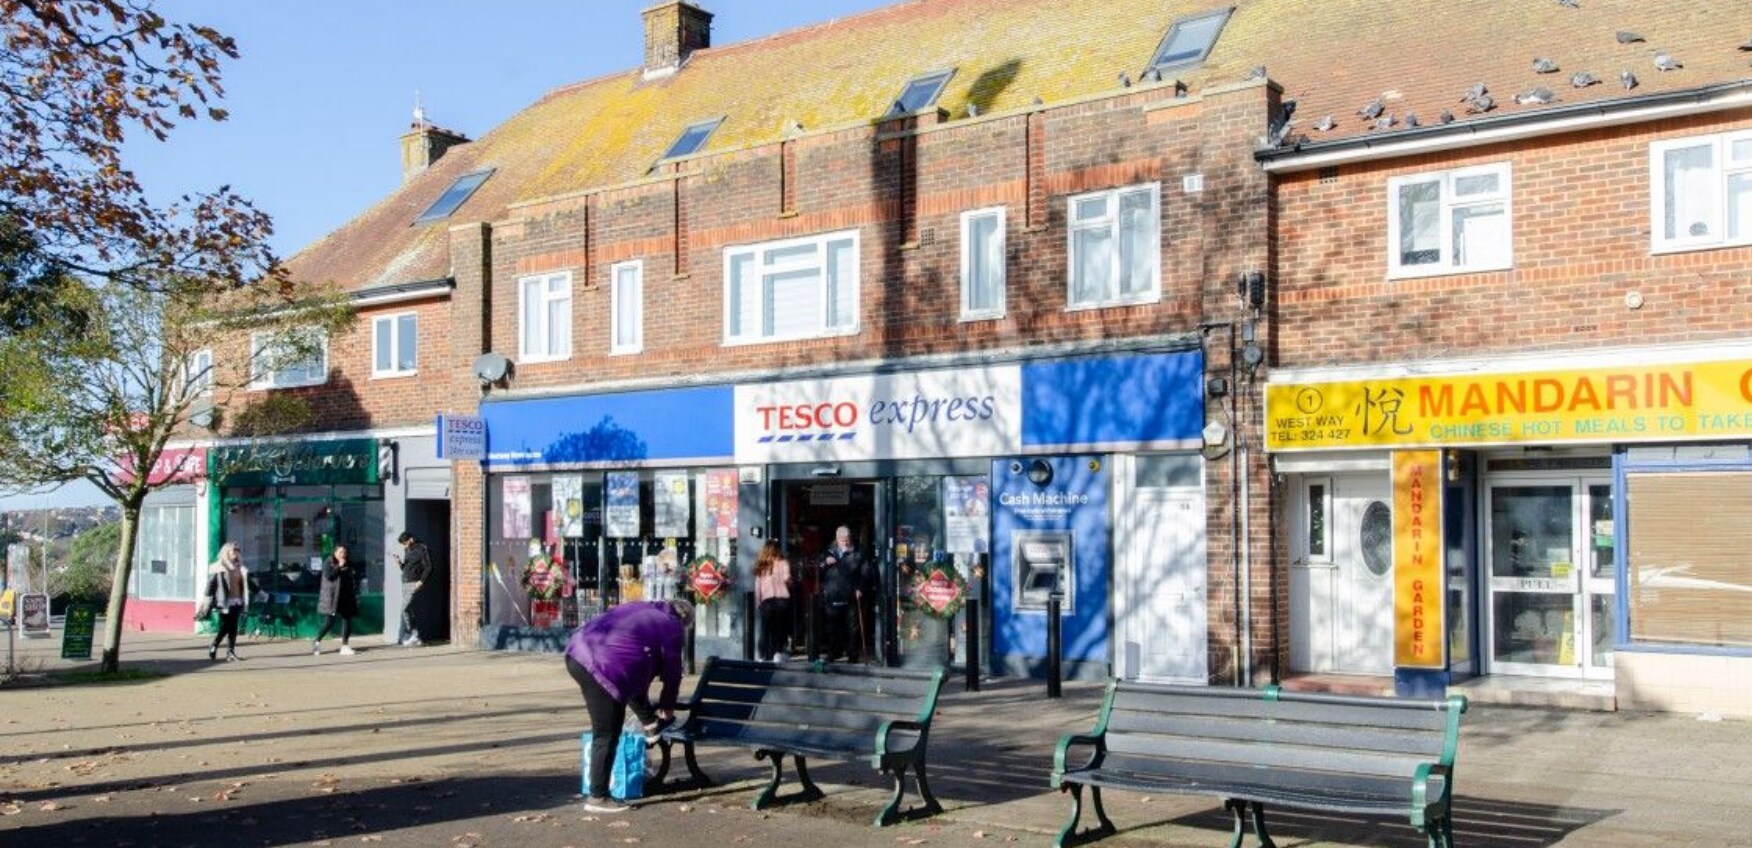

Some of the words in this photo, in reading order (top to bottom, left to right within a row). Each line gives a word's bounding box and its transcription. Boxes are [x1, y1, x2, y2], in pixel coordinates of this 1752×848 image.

[1418, 371, 1693, 418] MANDARIN
[756, 402, 858, 430] TESCO
[870, 395, 995, 433] express
[1276, 417, 1311, 429] WEST
[1316, 415, 1345, 427] WAY
[448, 419, 484, 430] TESCO
[1429, 421, 1513, 440] CHINESE
[1522, 420, 1563, 436] HOT
[1575, 416, 1648, 434] MEALS
[1657, 415, 1686, 432] TO
[449, 434, 482, 446] express
[1270, 431, 1297, 442] TEL:
[1301, 430, 1324, 441] 324
[1329, 429, 1352, 440] 427
[999, 491, 1028, 506] Cash
[1033, 491, 1089, 505] Machine
[1410, 463, 1423, 565] MANDARIN
[1412, 580, 1424, 657] GARDEN
